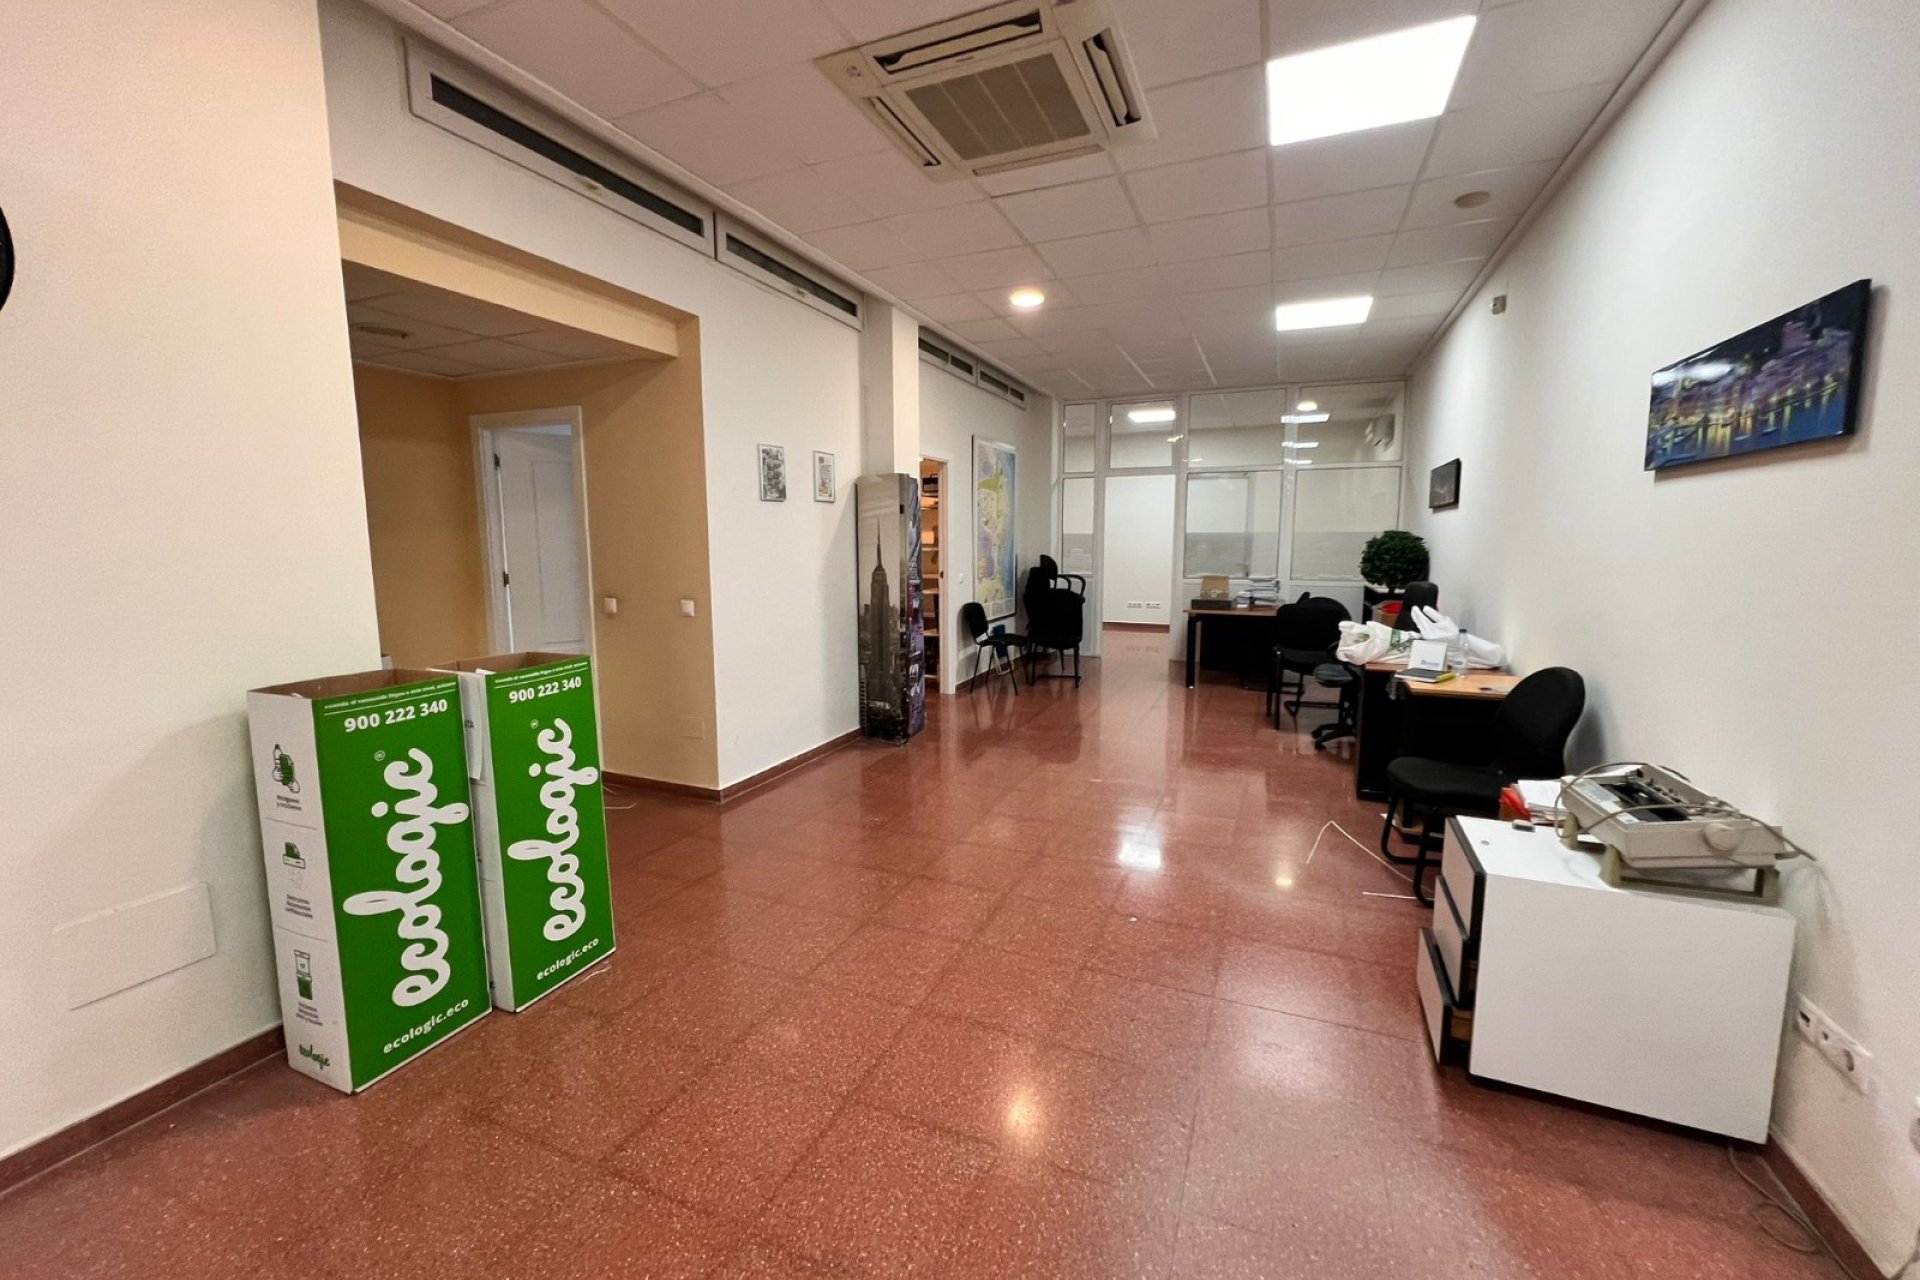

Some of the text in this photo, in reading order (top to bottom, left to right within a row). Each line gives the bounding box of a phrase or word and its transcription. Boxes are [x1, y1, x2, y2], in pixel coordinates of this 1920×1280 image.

[509, 676, 582, 704] 900 222 340
[344, 699, 448, 733] 900 222 340
[507, 717, 599, 942] ecologic
[342, 747, 470, 1007] ecologic
[536, 938, 599, 980] ecologic.eco
[383, 999, 469, 1054] ecologic.eco
